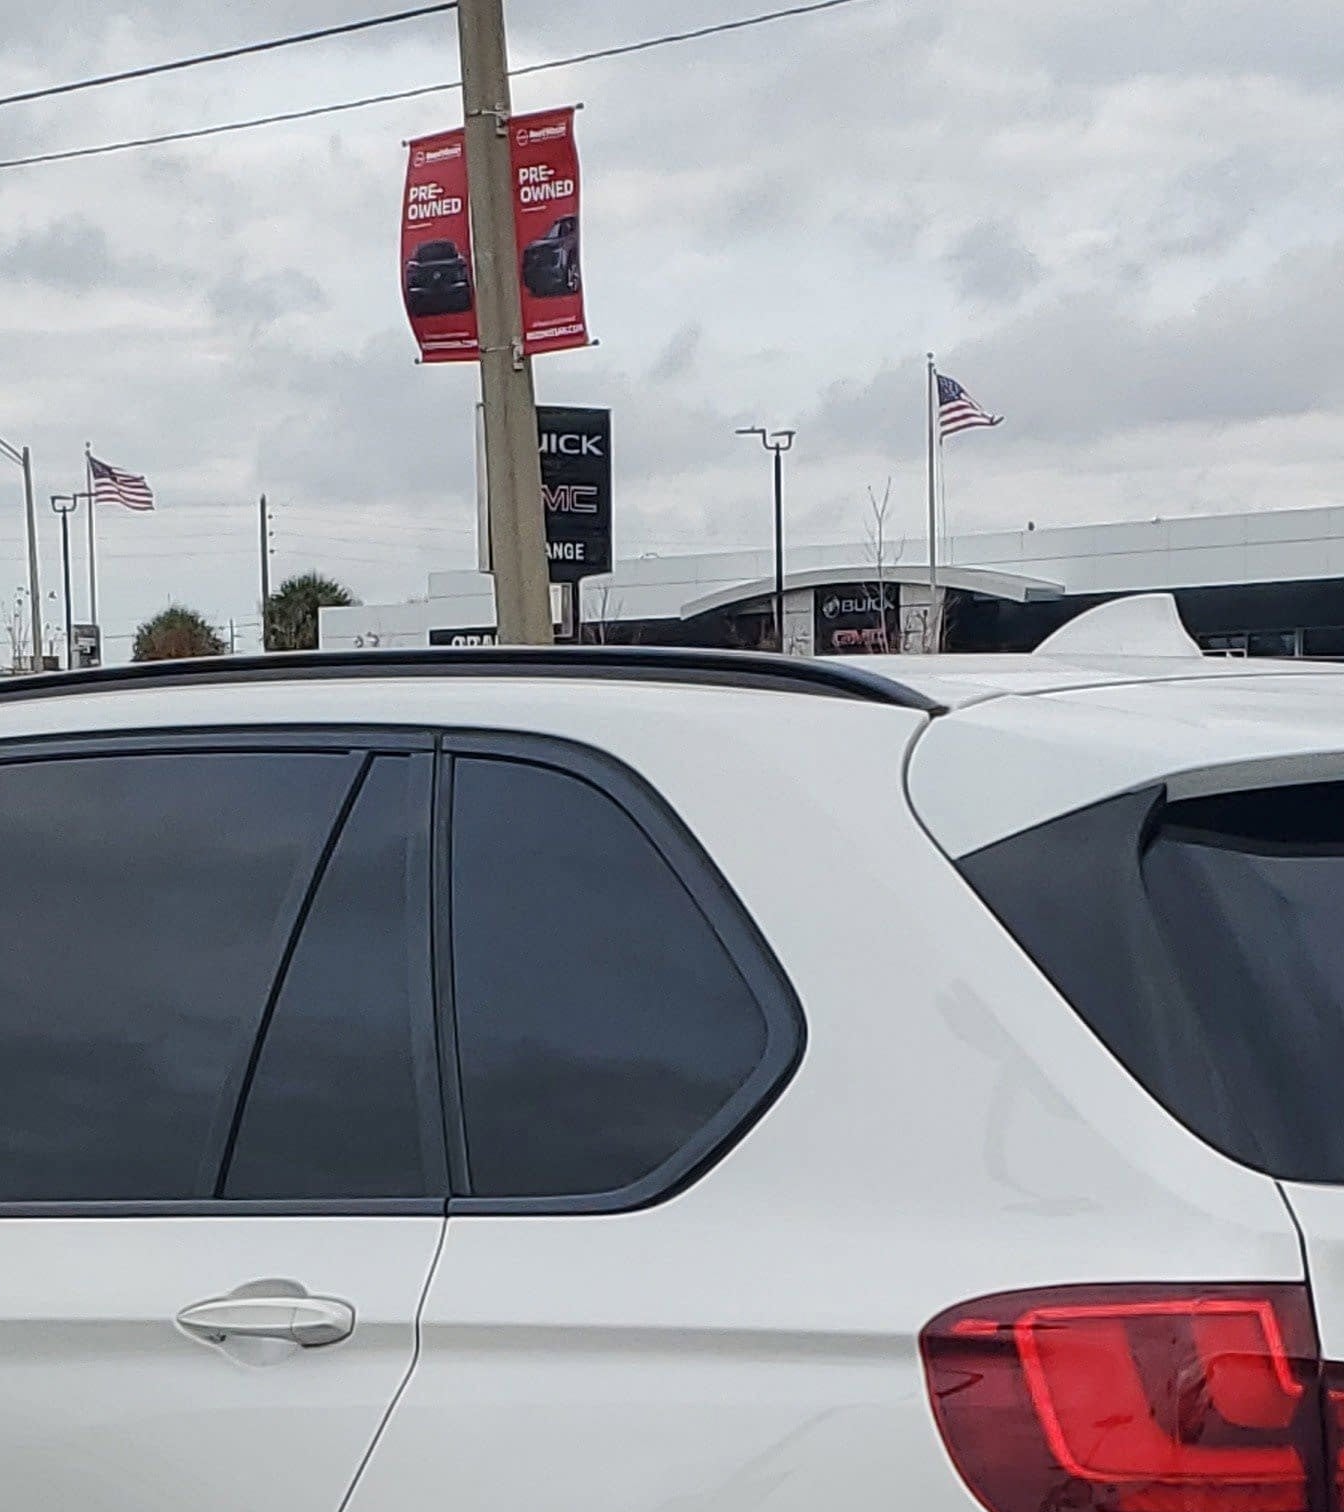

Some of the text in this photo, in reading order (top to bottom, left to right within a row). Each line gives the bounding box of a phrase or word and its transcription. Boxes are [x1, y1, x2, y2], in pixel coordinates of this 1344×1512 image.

[519, 165, 555, 185] PRE-
[409, 183, 444, 201] PRE-
[520, 179, 574, 203] OWNED
[408, 198, 462, 220] OWNED
[538, 433, 604, 456] UICK
[541, 484, 598, 513] MC
[544, 542, 585, 560] ANGE
